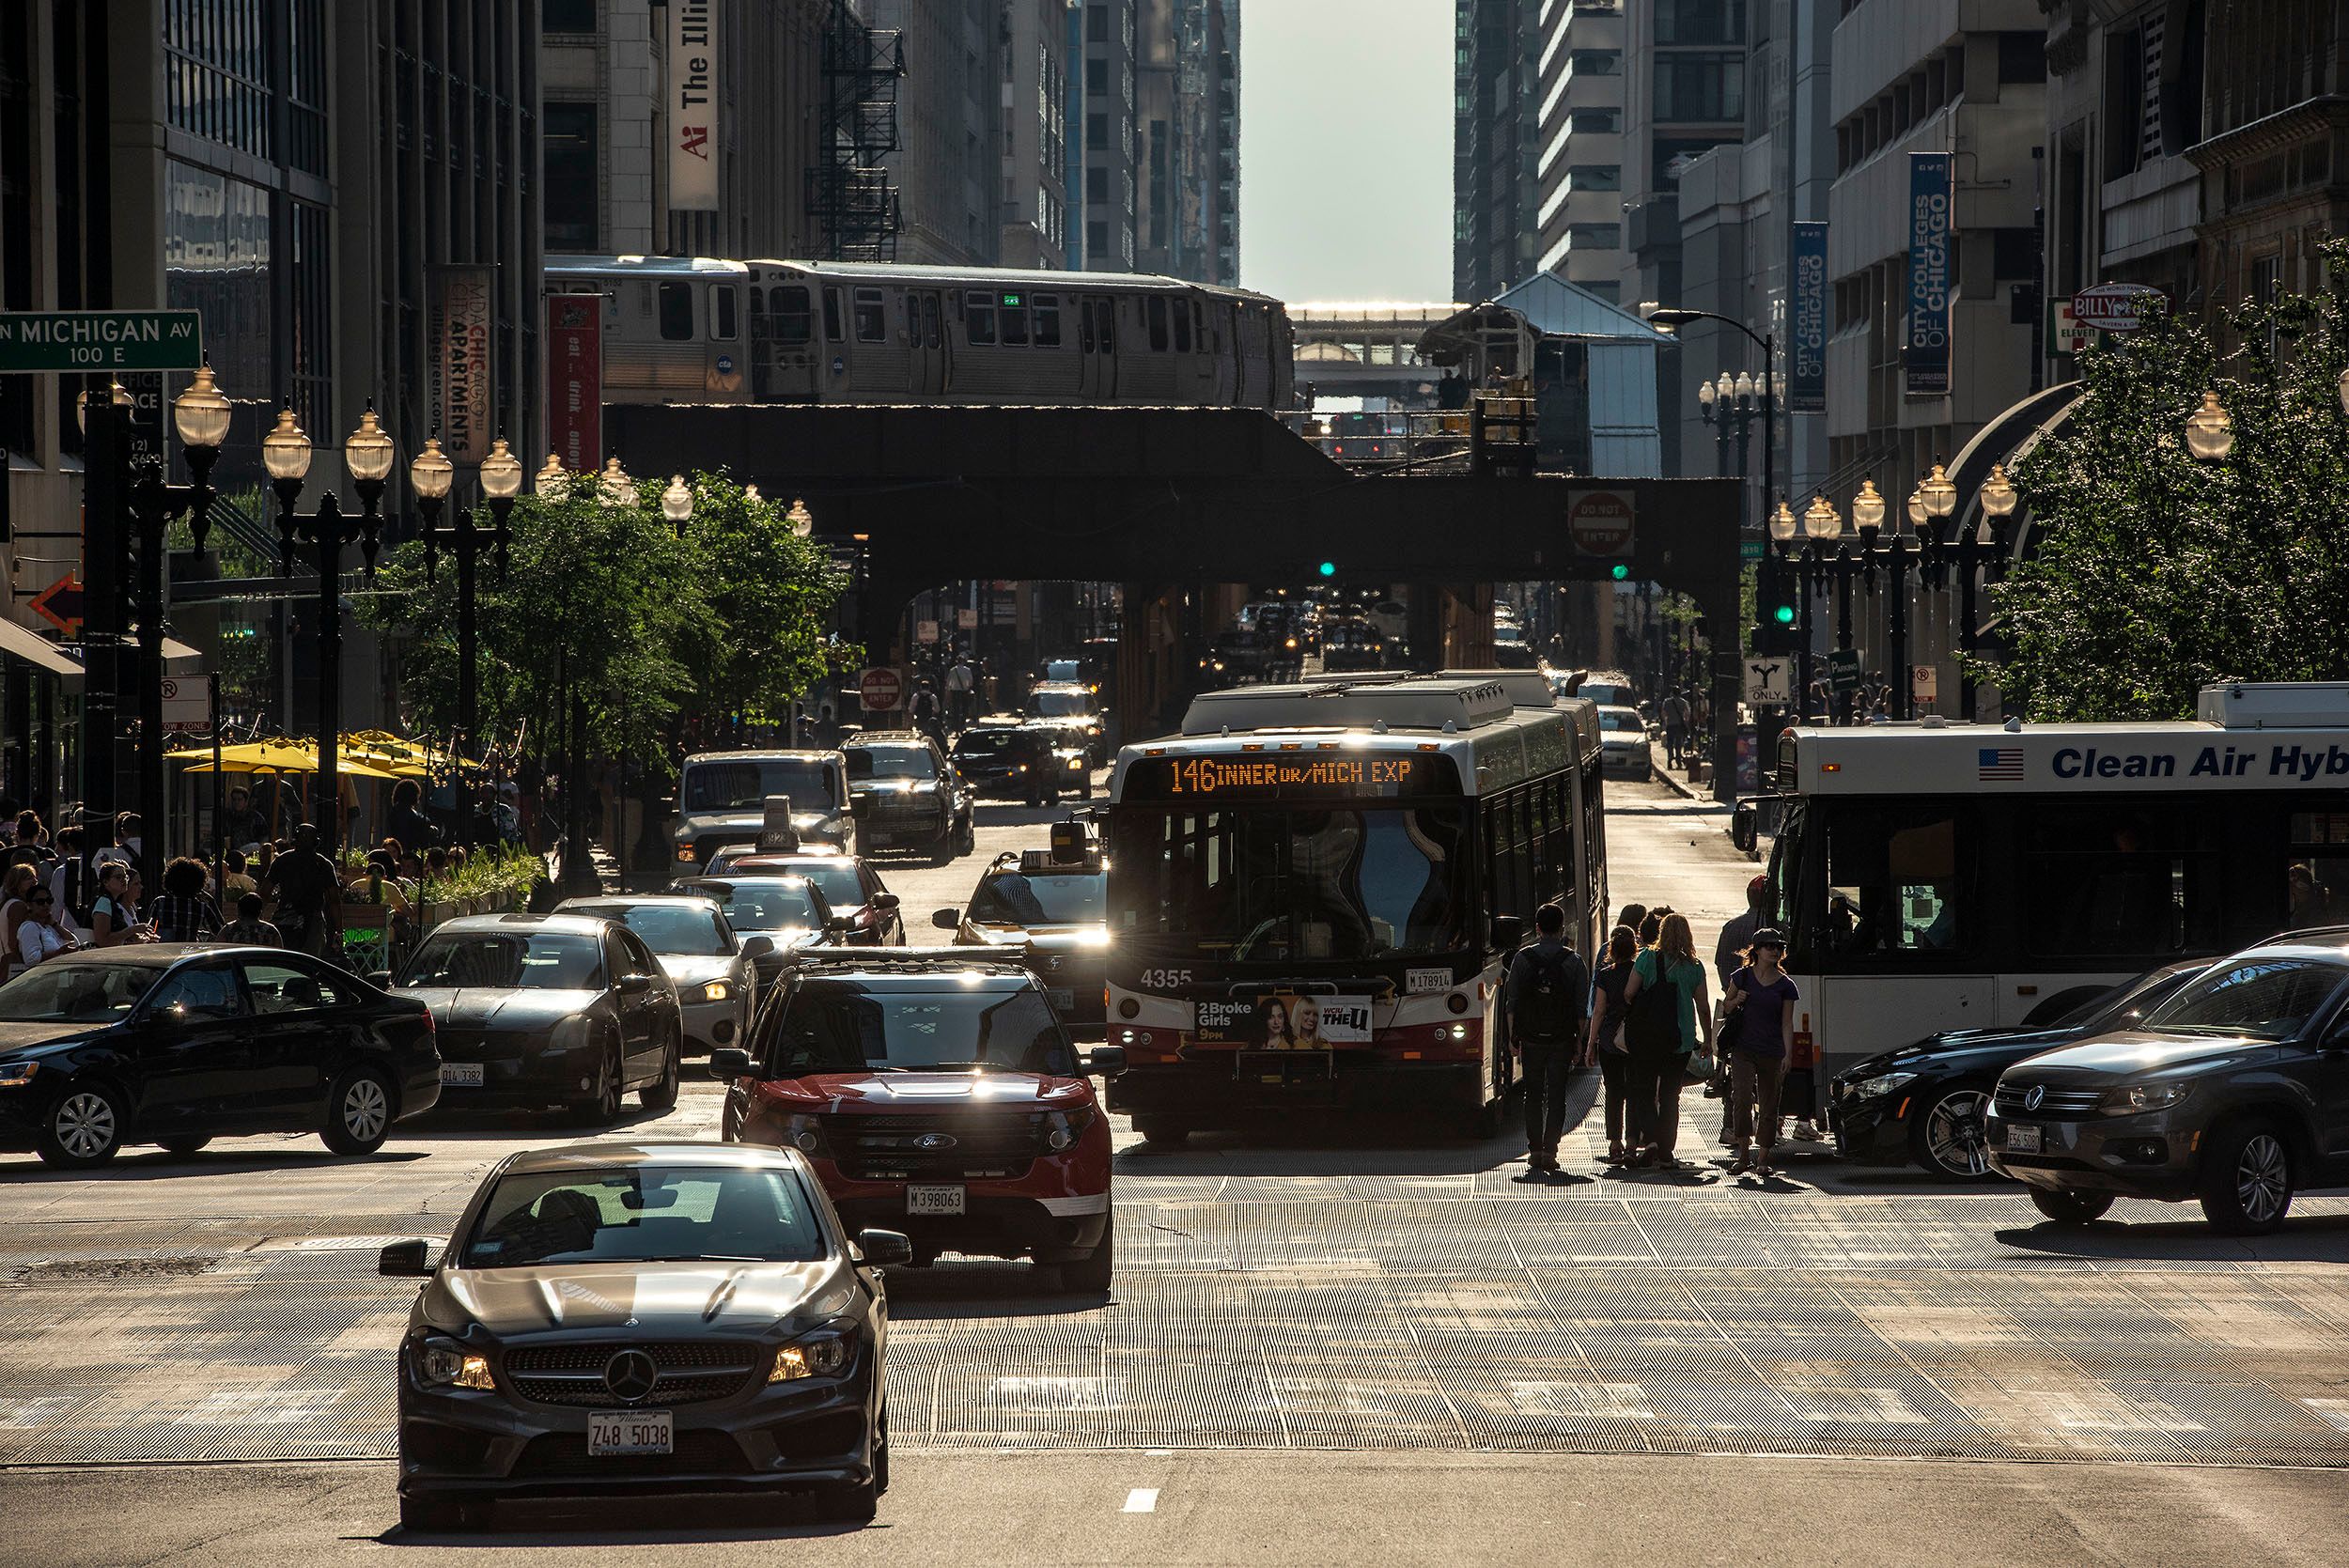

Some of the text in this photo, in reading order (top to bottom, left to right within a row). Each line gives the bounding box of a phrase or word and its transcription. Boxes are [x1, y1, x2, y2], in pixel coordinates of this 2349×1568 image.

[682, 57, 708, 109] The
[1913, 194, 1929, 348] CITY COLLEGES
[1928, 193, 1947, 348] OF CHICAGO
[1809, 254, 1824, 349] CHICAGO
[2075, 297, 2116, 317] BILLY
[1797, 256, 1809, 378] CITY COLLEGES
[0, 319, 193, 343] N MICHIGAN AV
[70, 348, 125, 364] 100 E
[719, 360, 732, 368] cta
[1809, 352, 1823, 378] OF
[119, 372, 162, 389] FFICE
[568, 380, 583, 413] drink
[1581, 504, 1620, 515] DO NOT
[1582, 532, 1621, 542] ENTER
[1752, 691, 1781, 701] ONLY
[163, 722, 207, 731] OW ZONE
[2052, 747, 2176, 780] Clean
[2189, 746, 2256, 778] Air
[1172, 759, 1411, 792] 146 INNER DR/MICH EXP
[1140, 969, 1192, 987] 4355
[1198, 1001, 1252, 1015] 2 Broke
[1198, 1015, 1232, 1027] Girls
[1322, 1013, 1351, 1025] THE
[461, 1070, 481, 1082] 3382
[592, 1424, 669, 1447] Z48 5038
